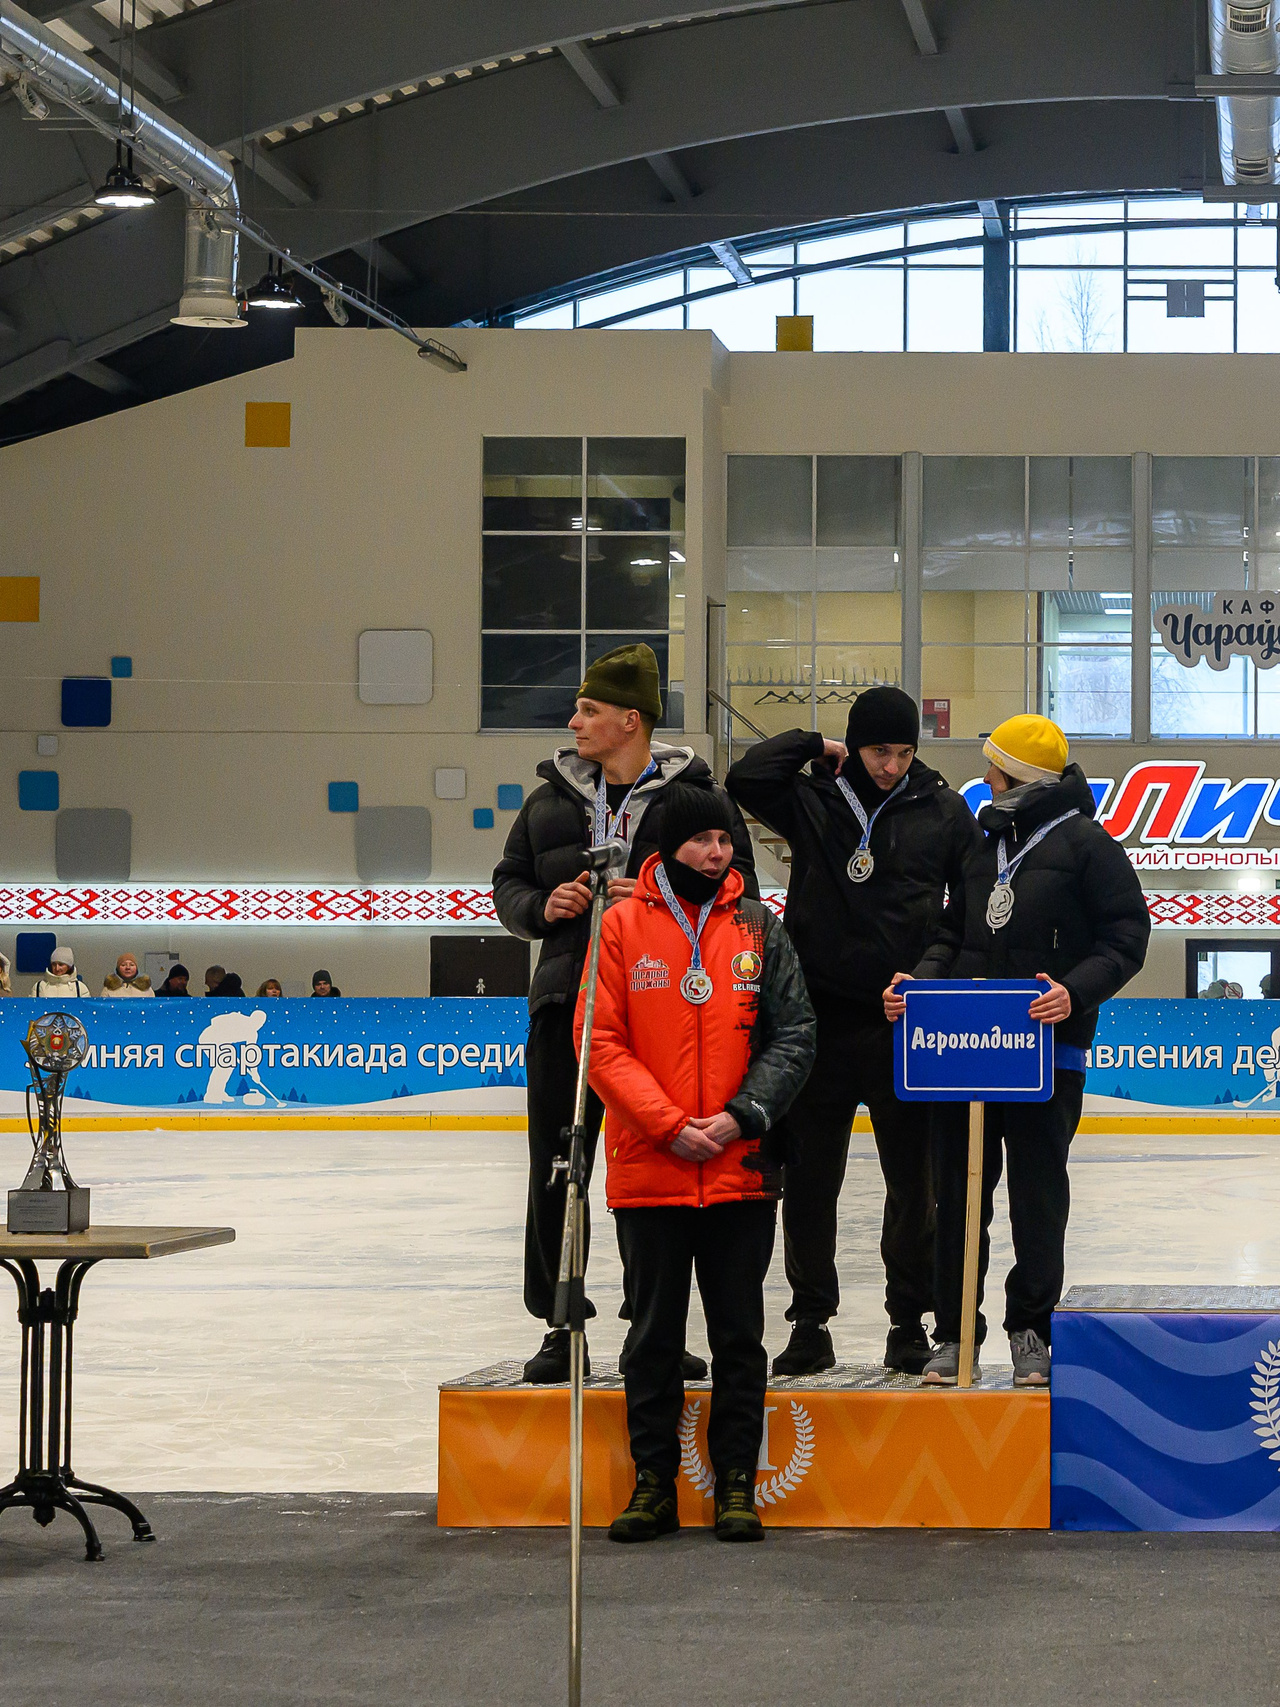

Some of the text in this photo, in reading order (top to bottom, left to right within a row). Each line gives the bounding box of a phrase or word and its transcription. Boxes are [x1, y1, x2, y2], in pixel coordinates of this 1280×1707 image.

[911, 1025, 1036, 1056] Агрохолдинг
[175, 1043, 408, 1075] спартакиада
[417, 1043, 526, 1075] среди
